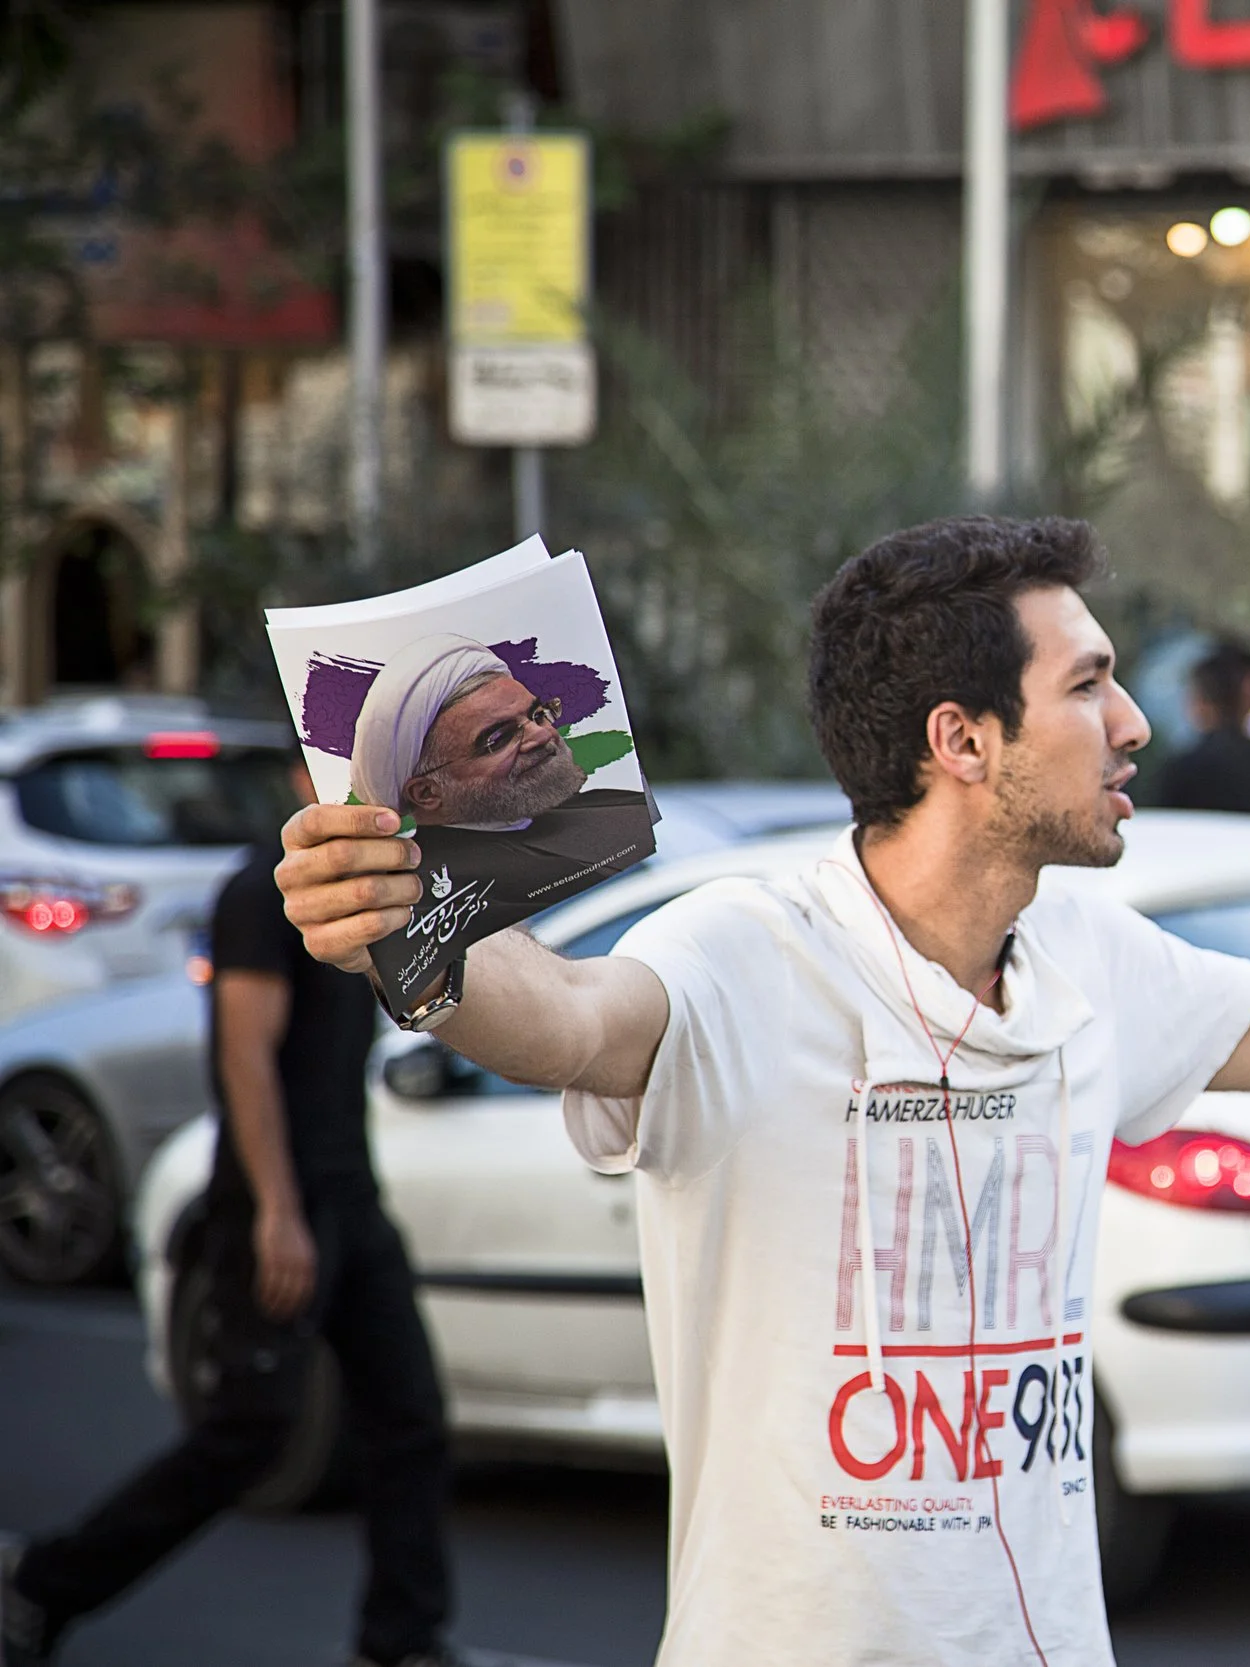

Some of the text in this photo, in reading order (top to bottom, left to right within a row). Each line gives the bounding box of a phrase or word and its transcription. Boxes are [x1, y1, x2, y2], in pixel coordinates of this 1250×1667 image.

[527, 844, 637, 898] www.setadrouhani.com
[406, 878, 495, 943] دکتر حسن روحانی
[397, 954, 418, 982] ایران
[401, 965, 422, 995] اسلام
[821, 1495, 917, 1512] EVERLASTING
[821, 1515, 837, 1529] BE
[846, 1516, 936, 1532] FASHIONABLE
[942, 1516, 971, 1529] WITH
